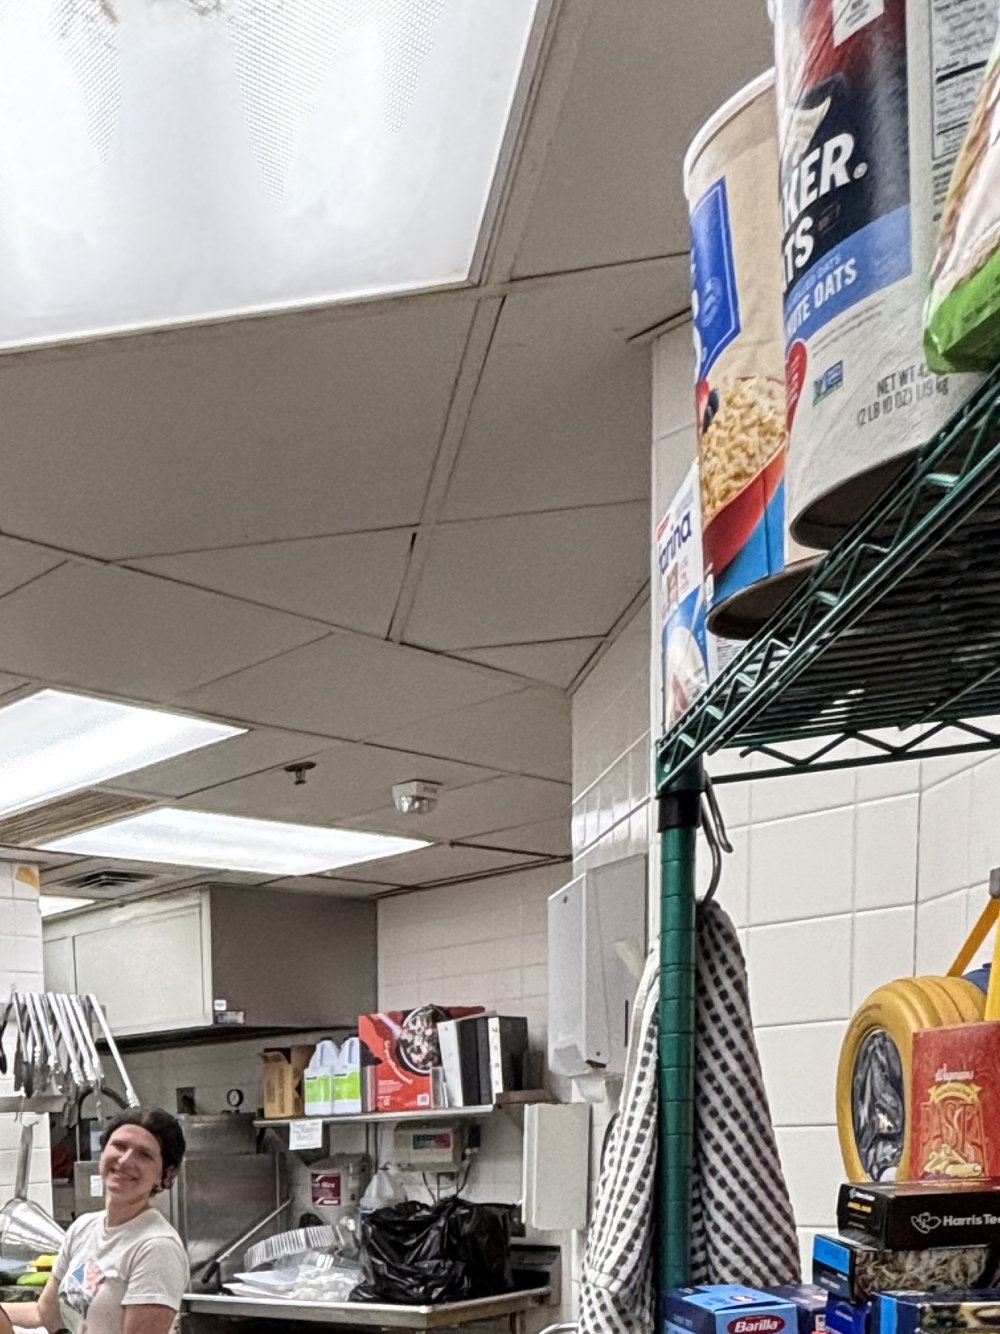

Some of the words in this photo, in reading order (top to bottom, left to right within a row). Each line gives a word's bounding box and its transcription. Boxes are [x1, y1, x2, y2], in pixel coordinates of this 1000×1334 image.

[813, 257, 858, 309] OATS
[876, 372, 896, 398] NET
[898, 365, 916, 388] WT
[943, 1213, 983, 1227] Harris
[734, 1317, 779, 1334] Barilla
